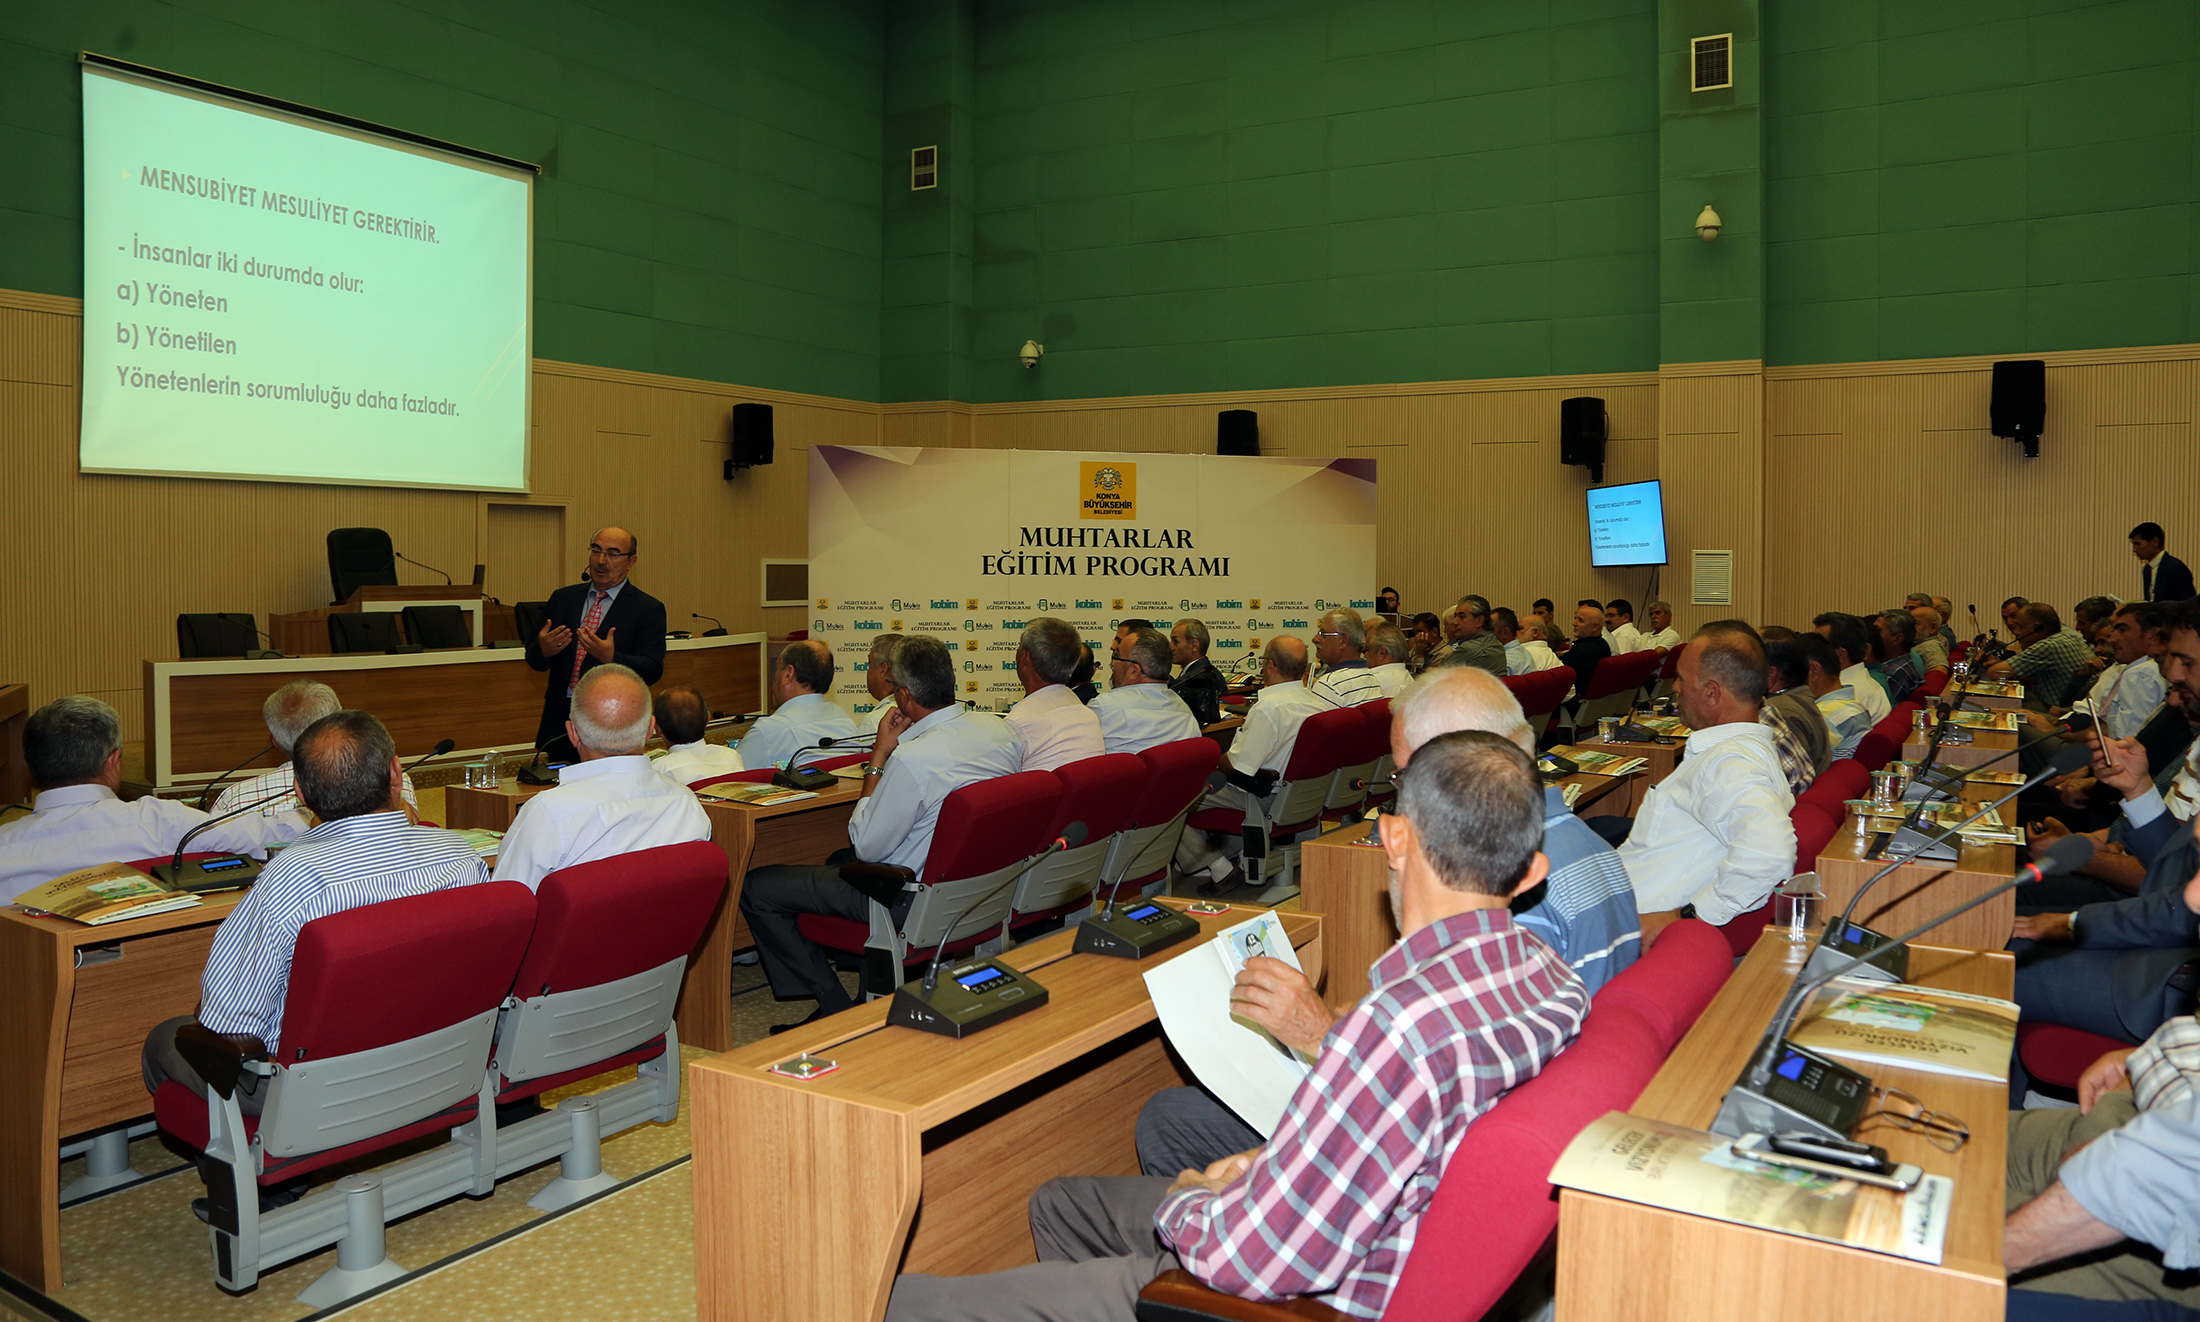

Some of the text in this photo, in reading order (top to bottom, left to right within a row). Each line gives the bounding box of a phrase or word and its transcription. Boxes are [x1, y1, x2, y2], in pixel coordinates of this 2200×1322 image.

[140, 165, 440, 245] MENSUBİYET MESULİYET GEREKTİRİR.
[133, 232, 212, 269] İnsanlar
[217, 251, 239, 274] iki
[243, 256, 324, 288] durumda
[329, 273, 365, 294] olur:
[117, 280, 228, 313] a) Yöneten
[117, 322, 237, 356] b) Yönetilen
[116, 365, 460, 418] Yönetenlerin sorumluluğu daha fazladır.
[1083, 500, 1133, 510] BÜYÜKŞEHİR
[1019, 527, 1194, 549] MUHTARLAR
[981, 549, 1231, 577] EĞİTİM PROGRAMI
[930, 599, 958, 609] kobim
[1075, 599, 1102, 608] kobim
[1216, 600, 1242, 608] kobim
[1350, 600, 1374, 608] kobim
[854, 620, 882, 629] kobim
[1151, 619, 1172, 628] obim
[1283, 619, 1308, 628] kobim
[1216, 639, 1242, 647] kobim
[854, 662, 869, 671] kob
[1002, 661, 1017, 670] kob
